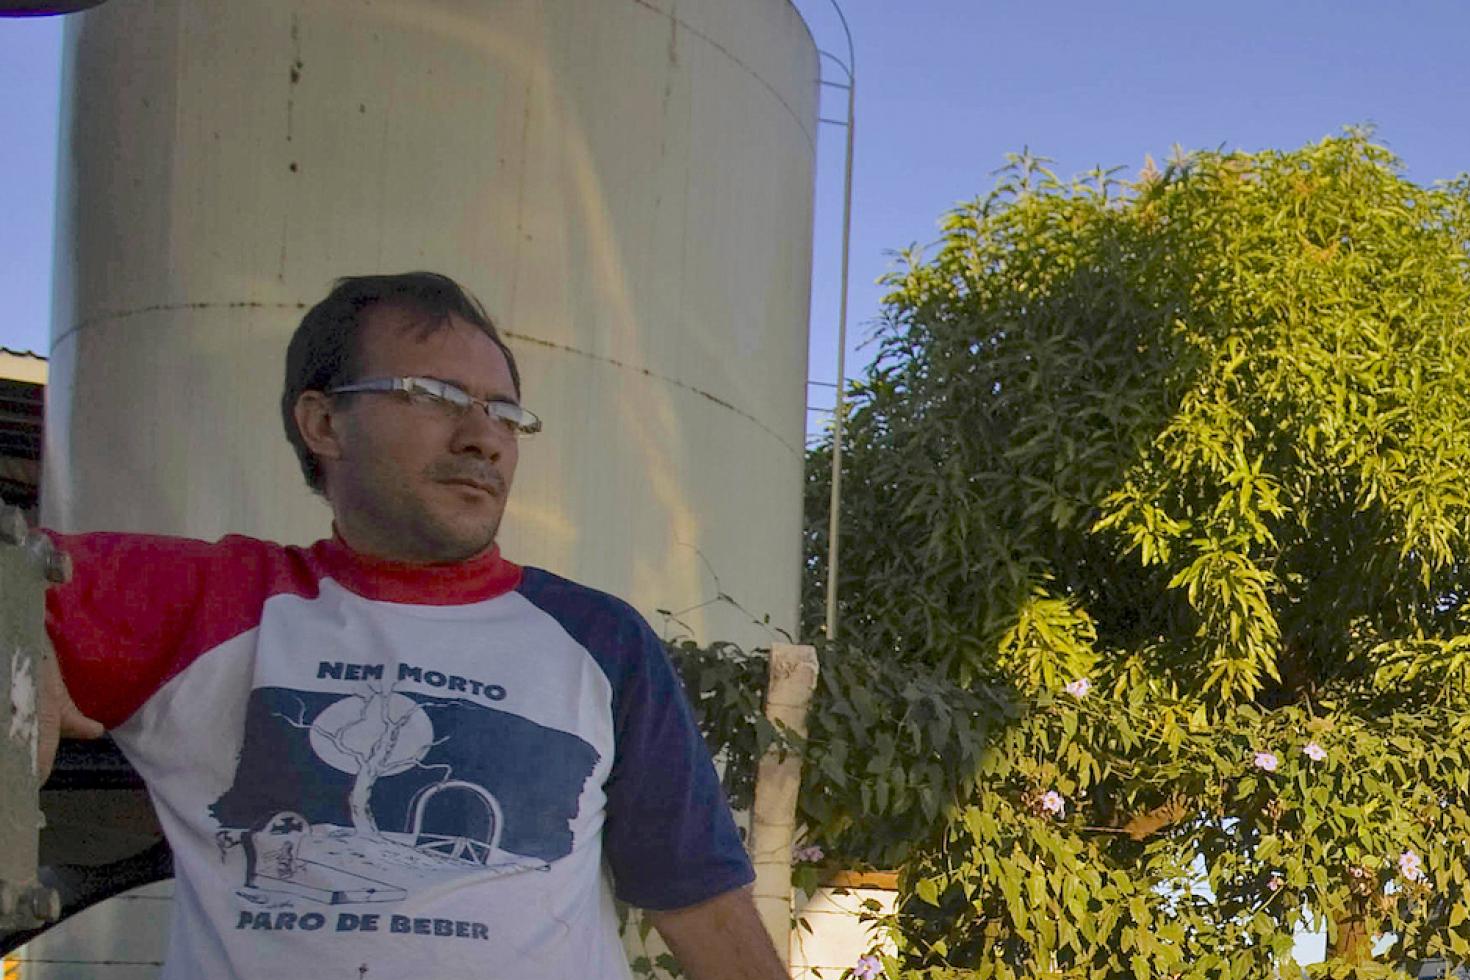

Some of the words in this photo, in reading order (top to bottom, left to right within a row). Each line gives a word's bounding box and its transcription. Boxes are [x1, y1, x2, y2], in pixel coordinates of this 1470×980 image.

[317, 661, 385, 680] NEM
[398, 662, 507, 701] MORTO
[236, 910, 325, 931] PARO
[336, 913, 380, 932] DE
[390, 915, 489, 940] BEBER
